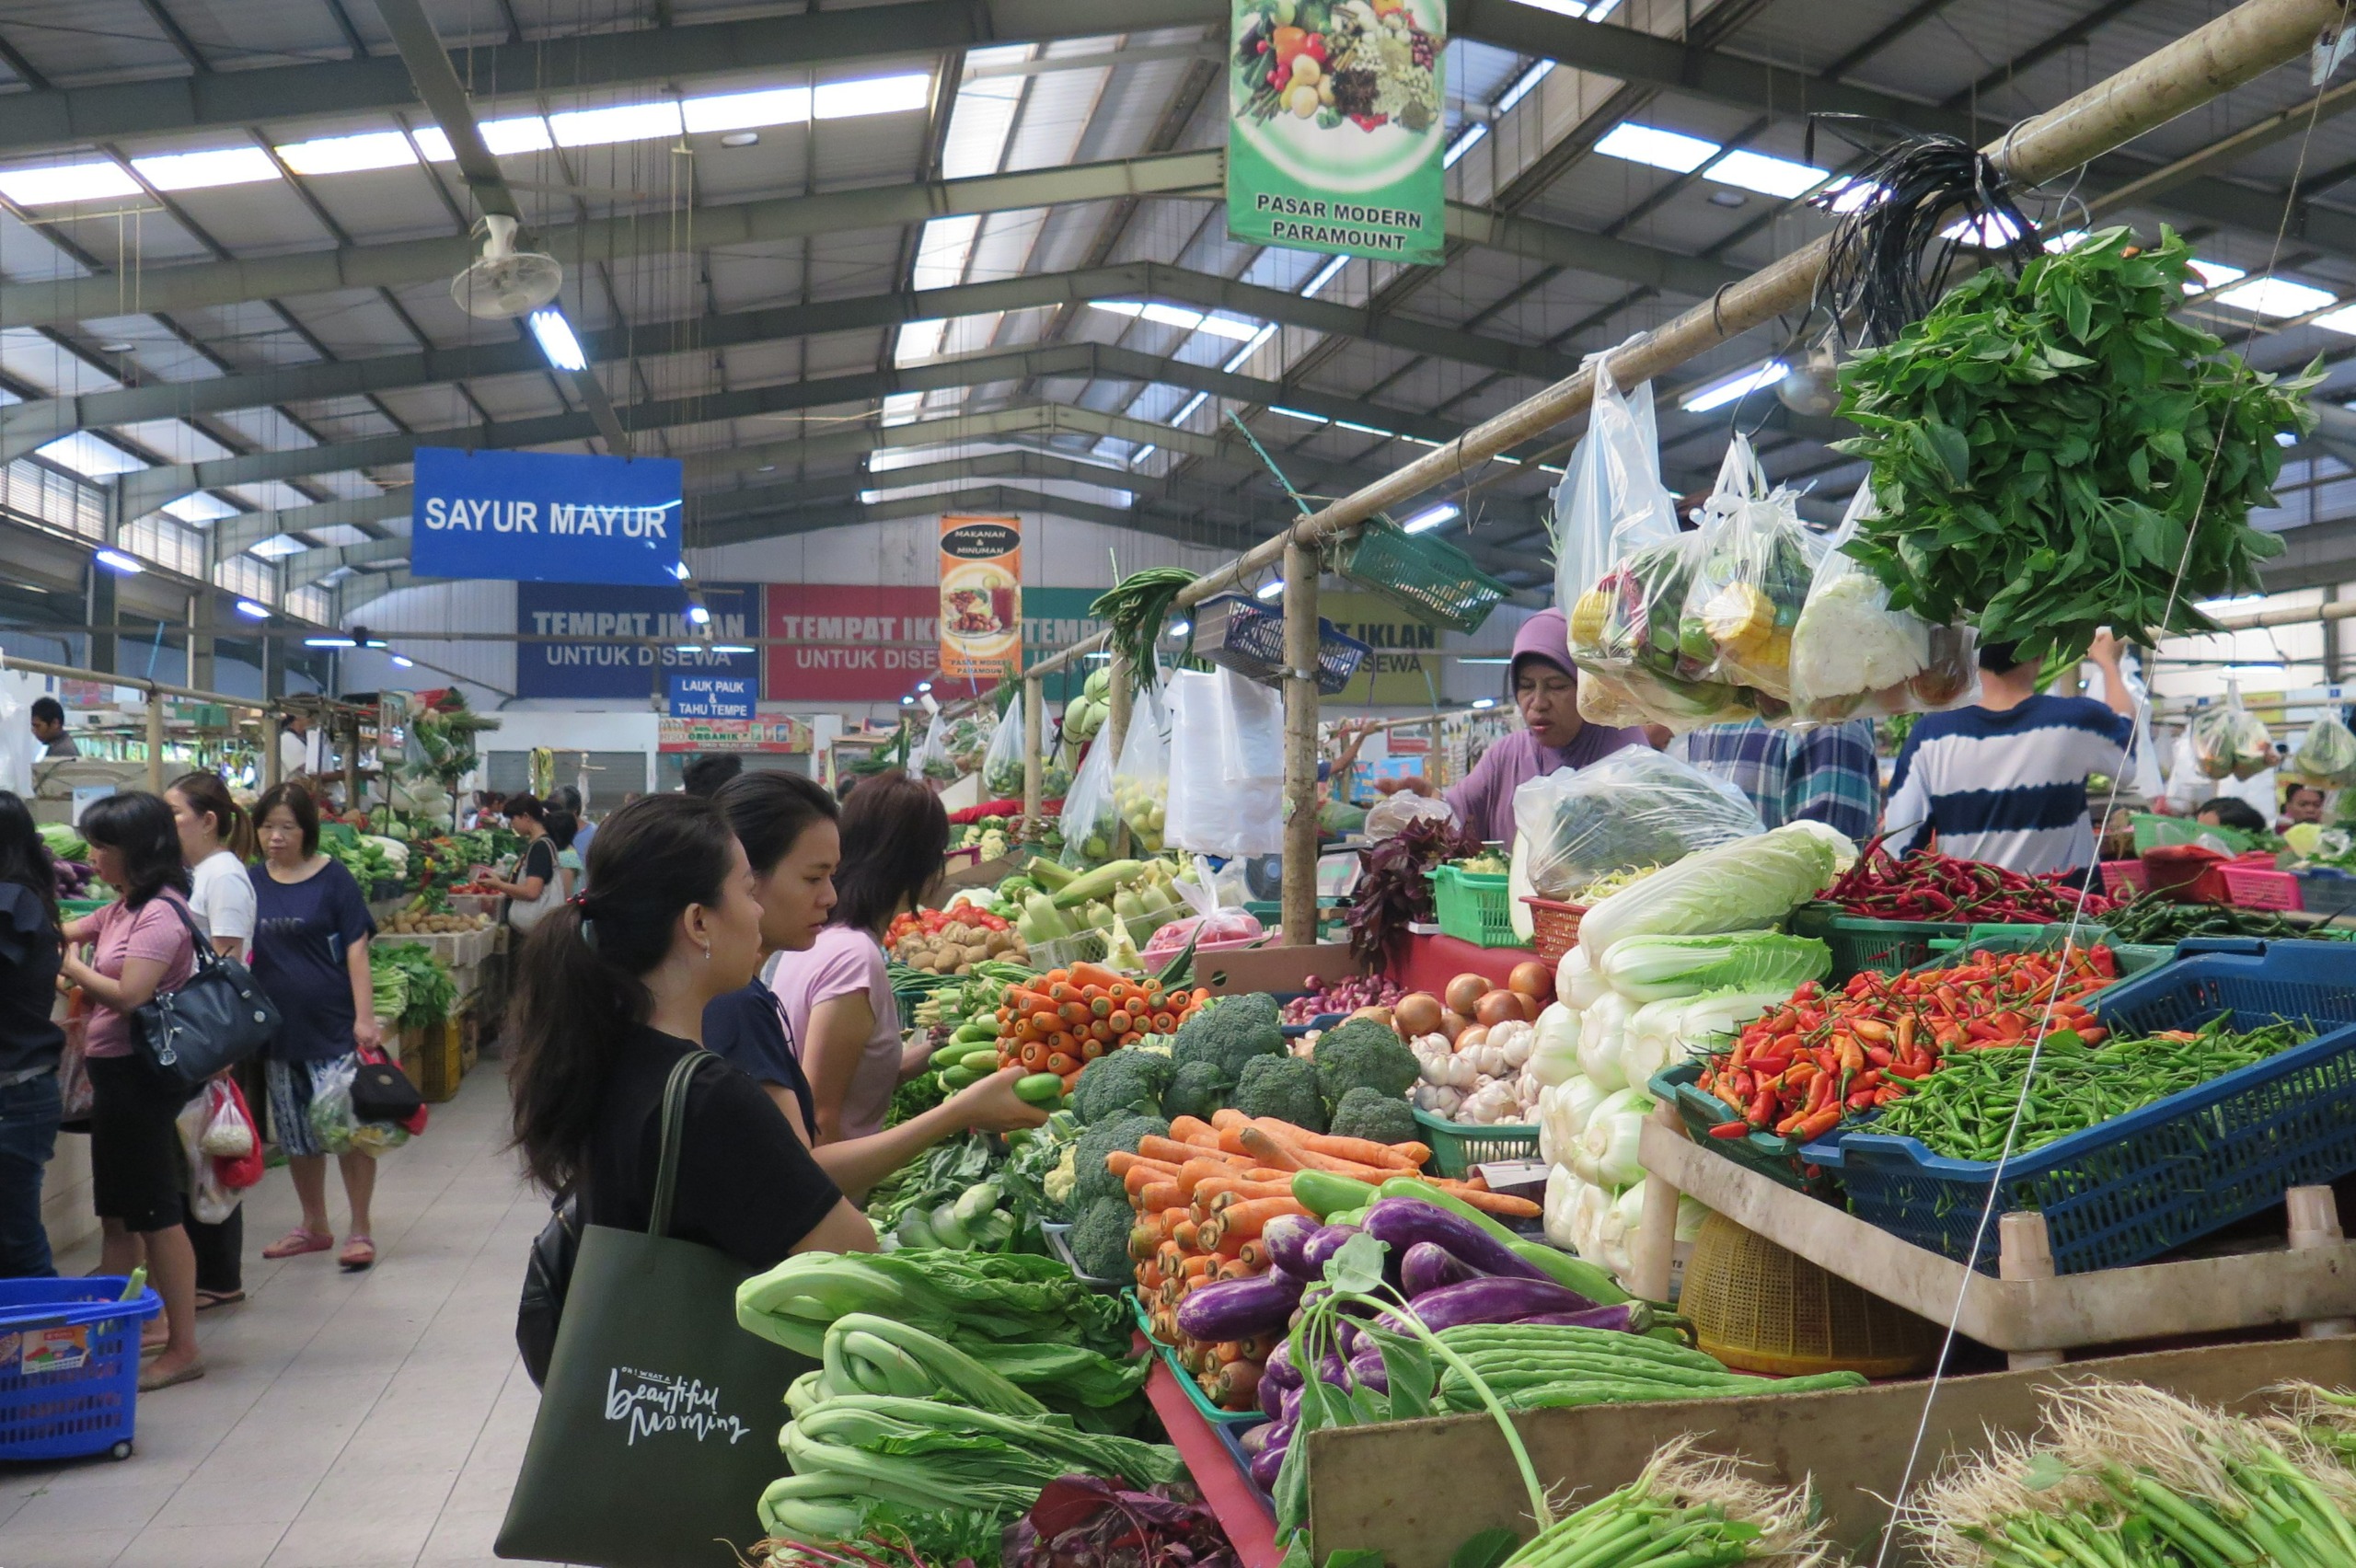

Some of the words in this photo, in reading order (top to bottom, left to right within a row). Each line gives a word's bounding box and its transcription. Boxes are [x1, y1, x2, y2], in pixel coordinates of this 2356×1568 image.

[1256, 193, 1327, 218] PASAR
[1334, 203, 1423, 229] MODERN
[1273, 221, 1407, 251] PARAMOUNT
[425, 497, 538, 534] SAYUR
[549, 502, 667, 539] MAYUR
[954, 530, 1007, 538] MAKANAN
[956, 547, 1005, 555] MINUMAN
[532, 611, 651, 638] TEMPAT
[782, 616, 897, 641] TEMPAT
[1022, 617, 1114, 644] TEMP
[1357, 624, 1436, 649] IKLAN
[546, 645, 630, 667] UNTUK
[795, 648, 878, 670] UNTUK
[884, 649, 941, 670] DISE
[1356, 654, 1423, 674] SEWA
[682, 680, 712, 692] LAUK
[715, 681, 745, 693] PAUK
[709, 693, 717, 704] &
[678, 703, 708, 715] TAHU
[710, 704, 747, 717] TEMPE
[639, 1370, 664, 1380] WHAT
[605, 1367, 720, 1420] beautiful
